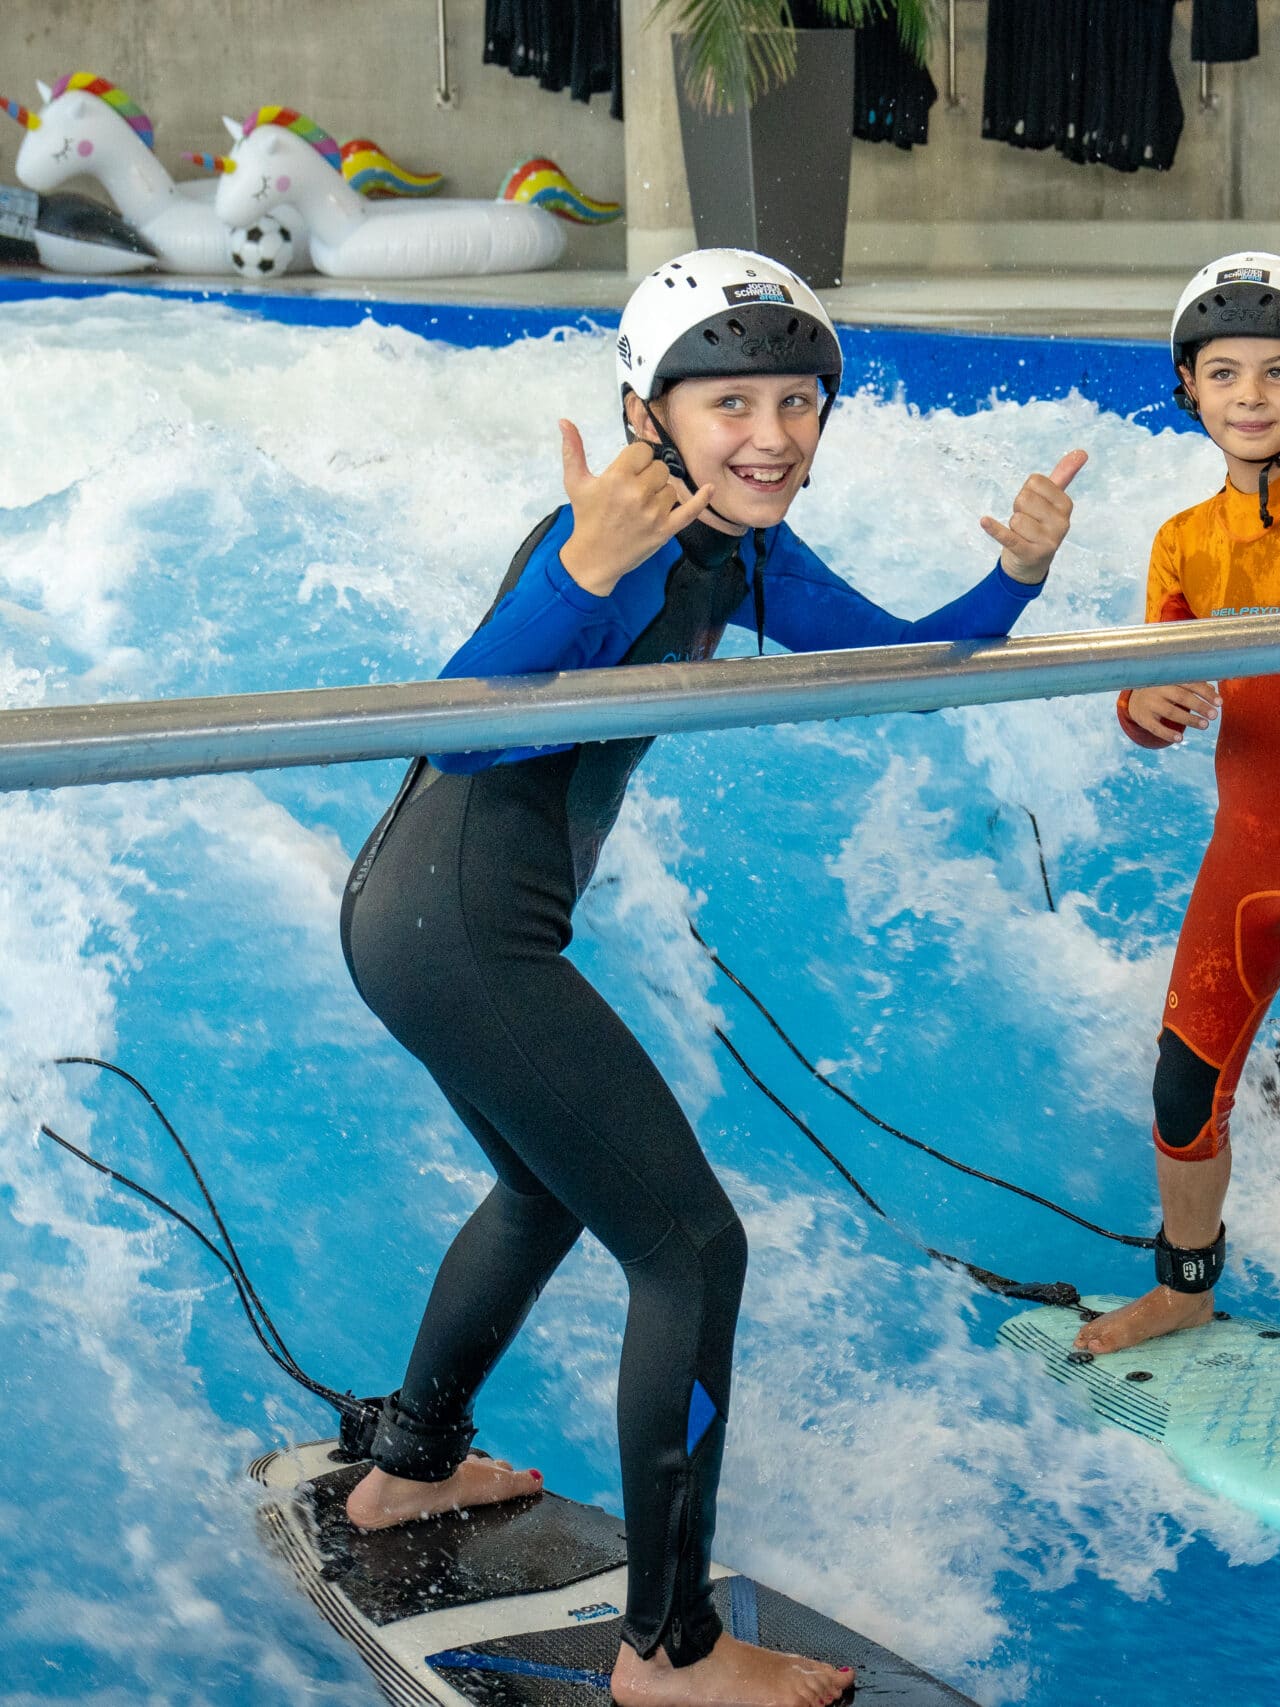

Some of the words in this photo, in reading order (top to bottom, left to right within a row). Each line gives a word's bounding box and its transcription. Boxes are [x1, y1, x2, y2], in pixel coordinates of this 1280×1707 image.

[746, 269, 757, 277] S
[745, 283, 780, 291] JOCHEN
[734, 288, 783, 298] SCHWEIZER
[759, 294, 785, 302] arena
